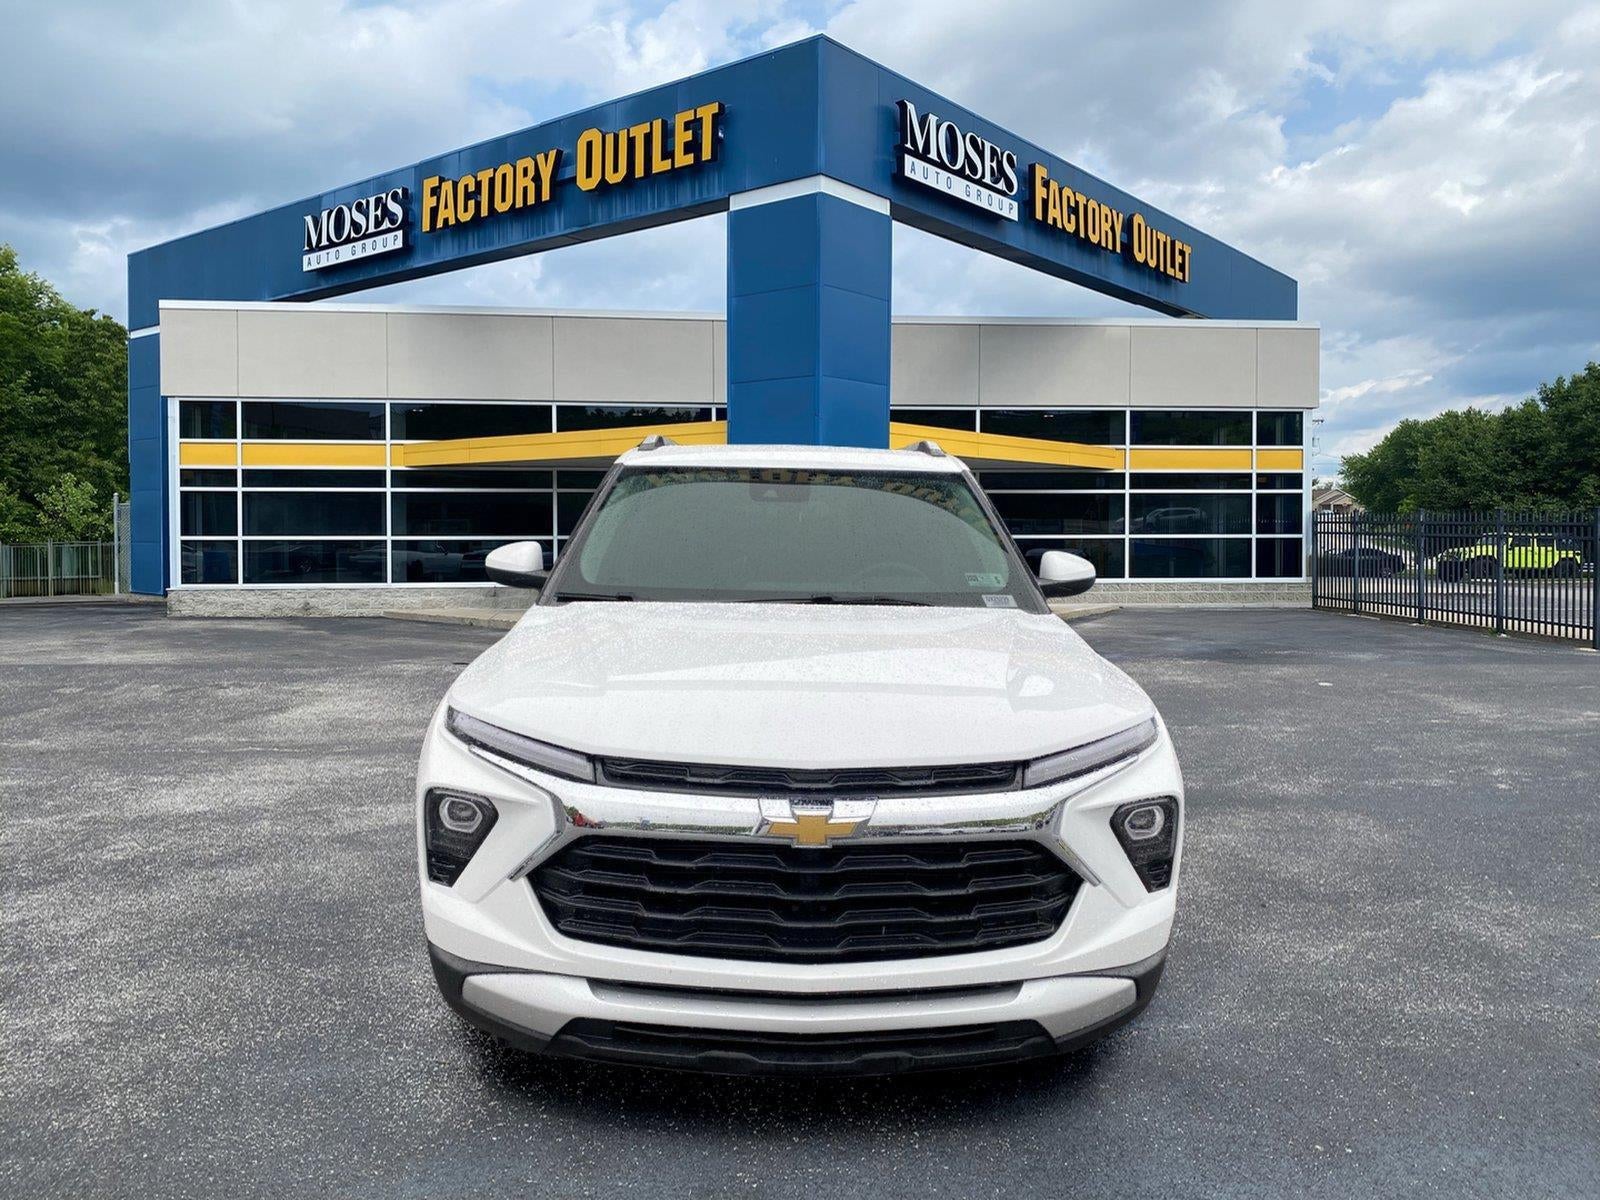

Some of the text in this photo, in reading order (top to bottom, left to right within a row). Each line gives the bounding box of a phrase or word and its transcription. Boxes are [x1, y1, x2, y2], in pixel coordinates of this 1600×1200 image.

[421, 101, 721, 233] FACTORY OUTLET
[903, 99, 1019, 196] MOSES
[909, 160, 1015, 215] AUTO GROUP
[303, 187, 403, 252] MOSES
[306, 233, 400, 268] AUTO GROUP
[1034, 162, 1192, 283] FACTORY OUTLET
